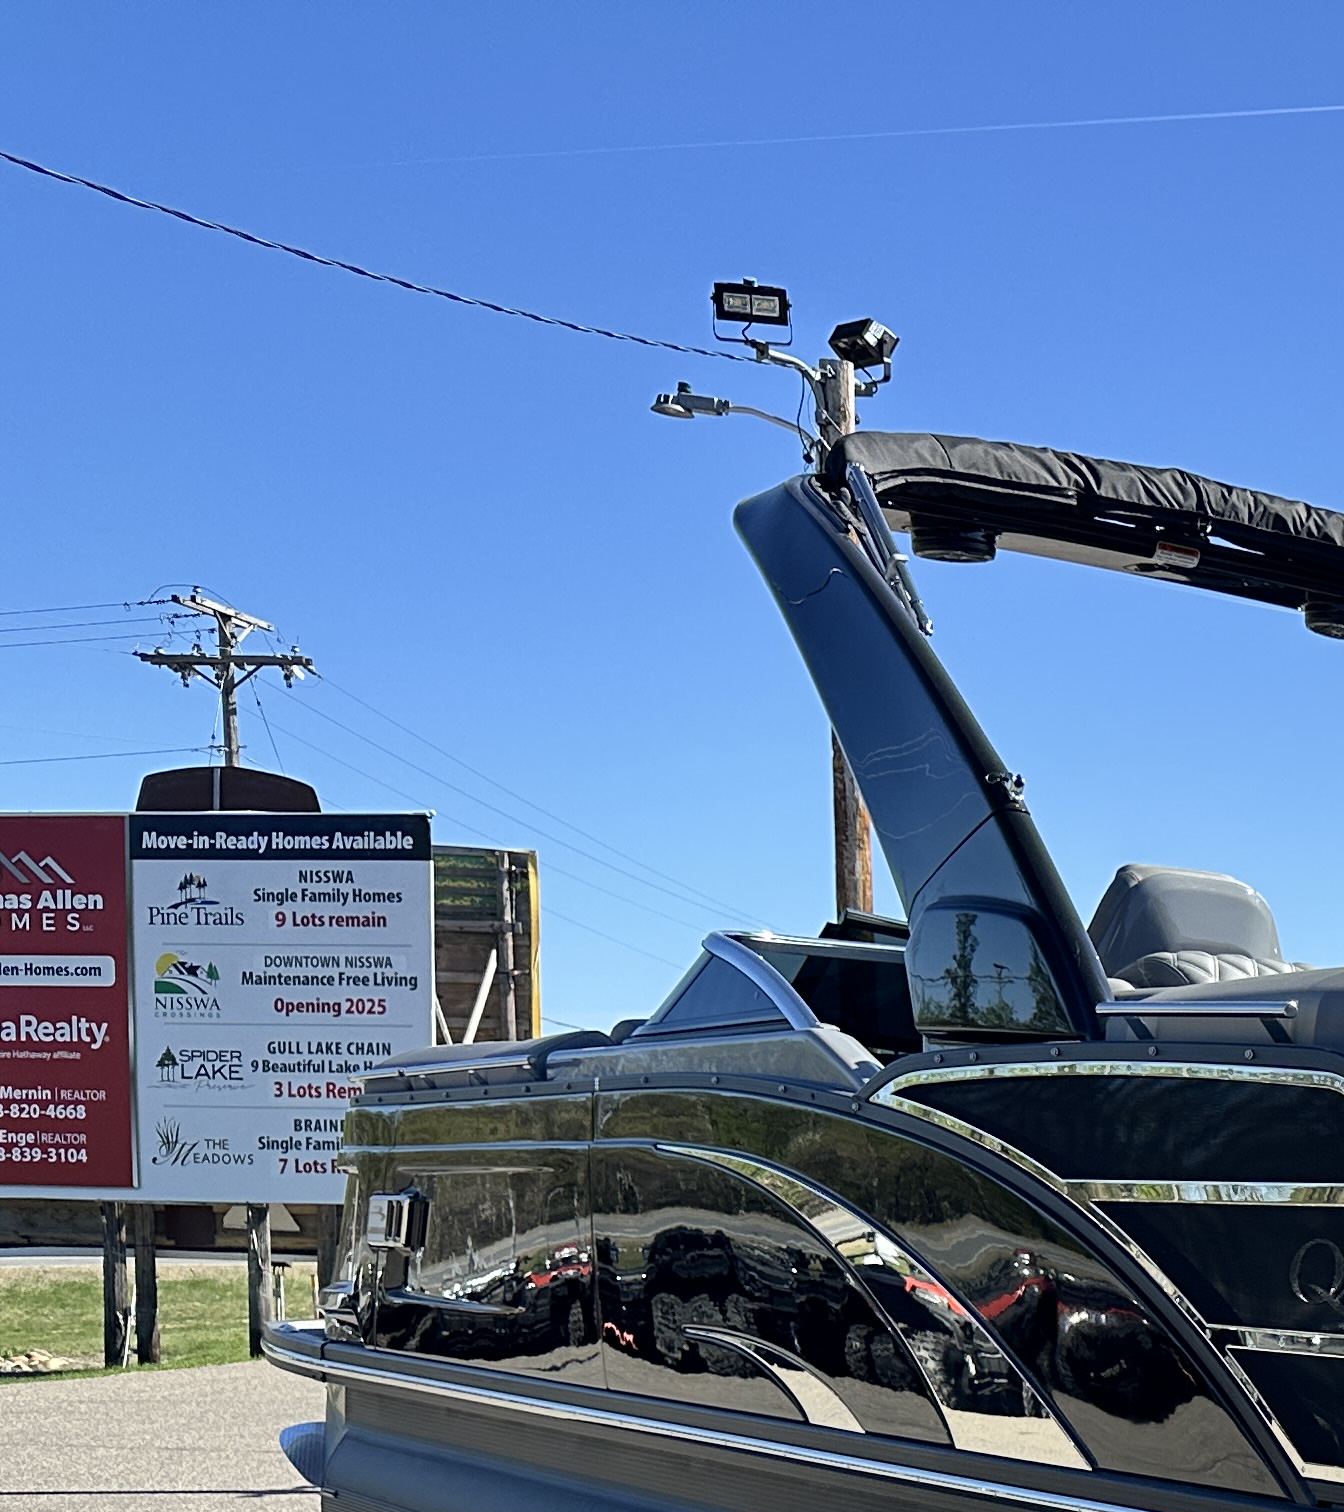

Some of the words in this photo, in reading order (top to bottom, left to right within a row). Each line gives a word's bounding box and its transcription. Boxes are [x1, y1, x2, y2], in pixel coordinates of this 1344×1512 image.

[142, 831, 268, 854] Move-in-Ready
[271, 832, 329, 850] Homes
[332, 831, 414, 850] Available
[299, 870, 355, 884] NISSWA
[37, 889, 104, 910] Allen
[253, 888, 298, 906] Single
[301, 888, 349, 906] Family
[352, 888, 403, 903] Homes
[147, 906, 189, 926] Pine
[190, 906, 245, 926] Trails
[274, 911, 287, 928] 9
[292, 911, 325, 928] Lots
[328, 911, 387, 928] remain
[264, 955, 340, 968] DOWNTOWN
[344, 956, 393, 969] NISSWA
[241, 971, 335, 987] Maintenance
[338, 972, 370, 987] Free
[373, 972, 418, 991] Living
[154, 996, 222, 1011] NISSWA
[274, 997, 342, 1018] Opening
[345, 998, 387, 1015] 2025
[178, 1049, 242, 1062] SPIDER
[267, 1041, 303, 1055] GULL
[307, 1041, 342, 1055] LAKE
[346, 1042, 392, 1056] CHAIN
[180, 1063, 243, 1081] LAKE
[250, 1060, 259, 1073] 9
[262, 1059, 325, 1074] Beautiful
[328, 1060, 361, 1074] Lake
[0, 1086, 51, 1100] Mernin
[60, 1090, 106, 1101] REALTOR
[274, 1081, 283, 1098] 3
[287, 1081, 322, 1098] Lots
[0, 1129, 35, 1146] Enge
[41, 1133, 87, 1145] REALTOR
[204, 1139, 229, 1150] THE
[257, 1136, 302, 1154] Single
[278, 1158, 288, 1174] 7
[294, 1159, 327, 1174] Lots
